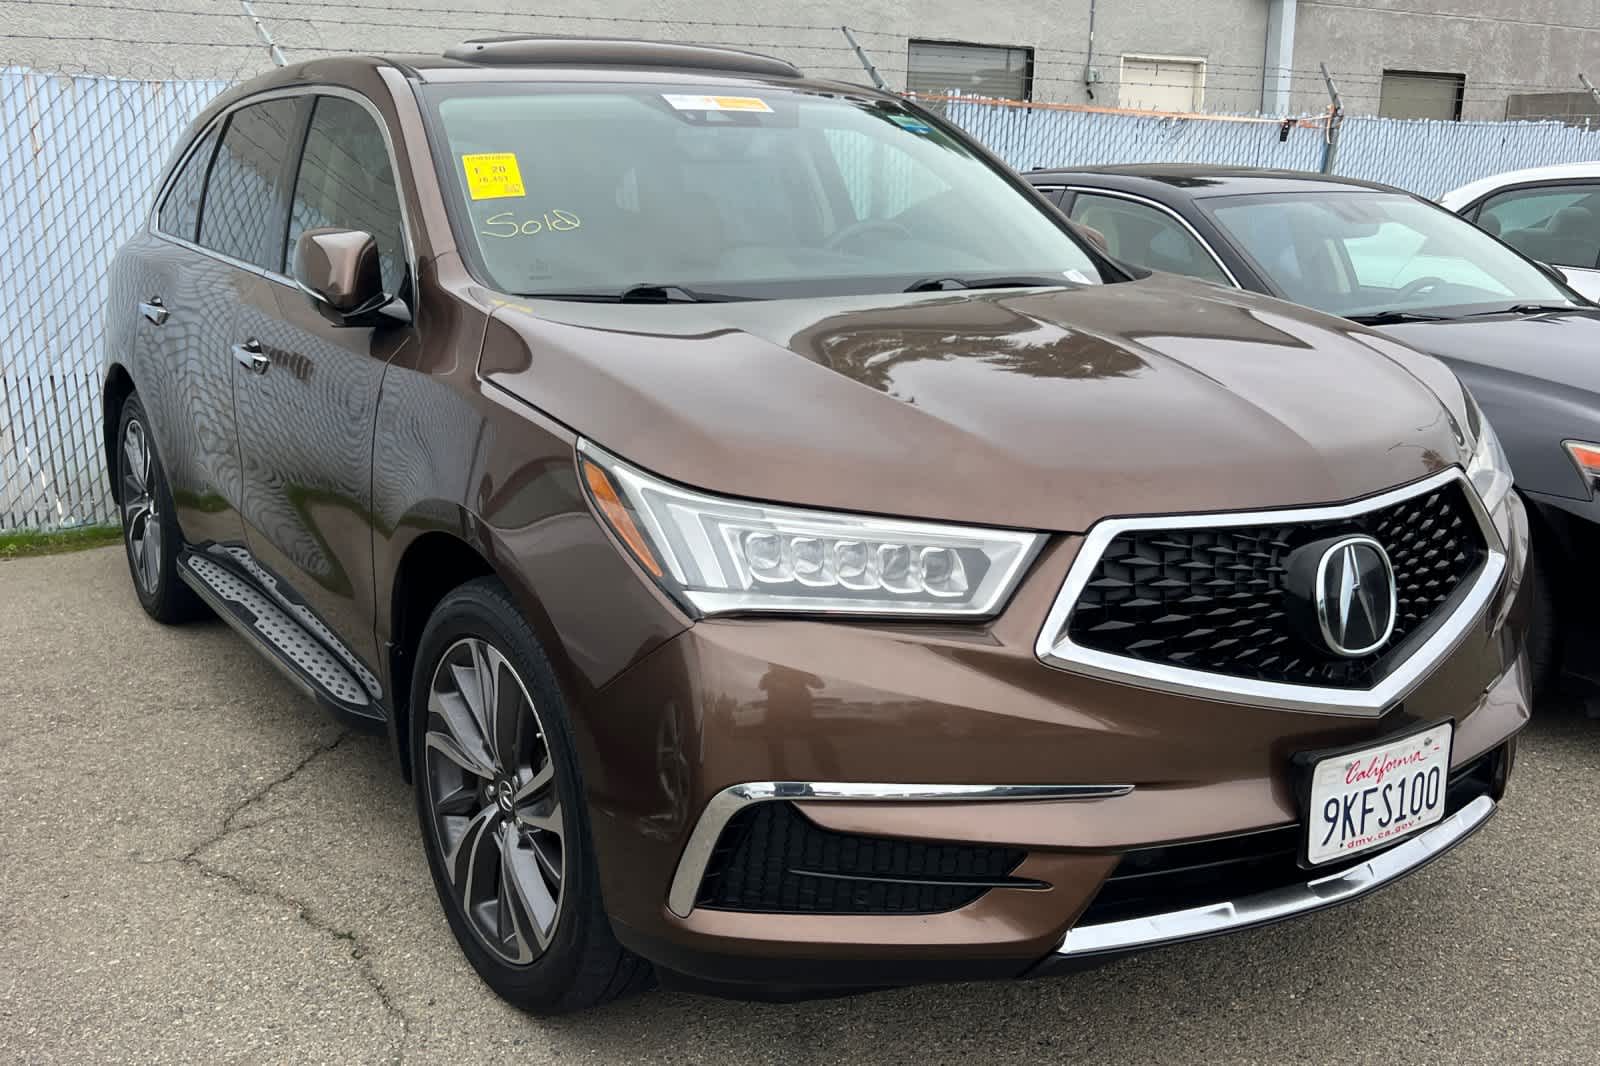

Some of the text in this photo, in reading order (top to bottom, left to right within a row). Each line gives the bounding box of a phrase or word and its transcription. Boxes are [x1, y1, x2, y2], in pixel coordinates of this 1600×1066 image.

[481, 209, 580, 238] Sold
[1346, 750, 1428, 784] California
[1322, 766, 1440, 847] 9KFS100
[1347, 820, 1415, 849] dmv.ca.gov
